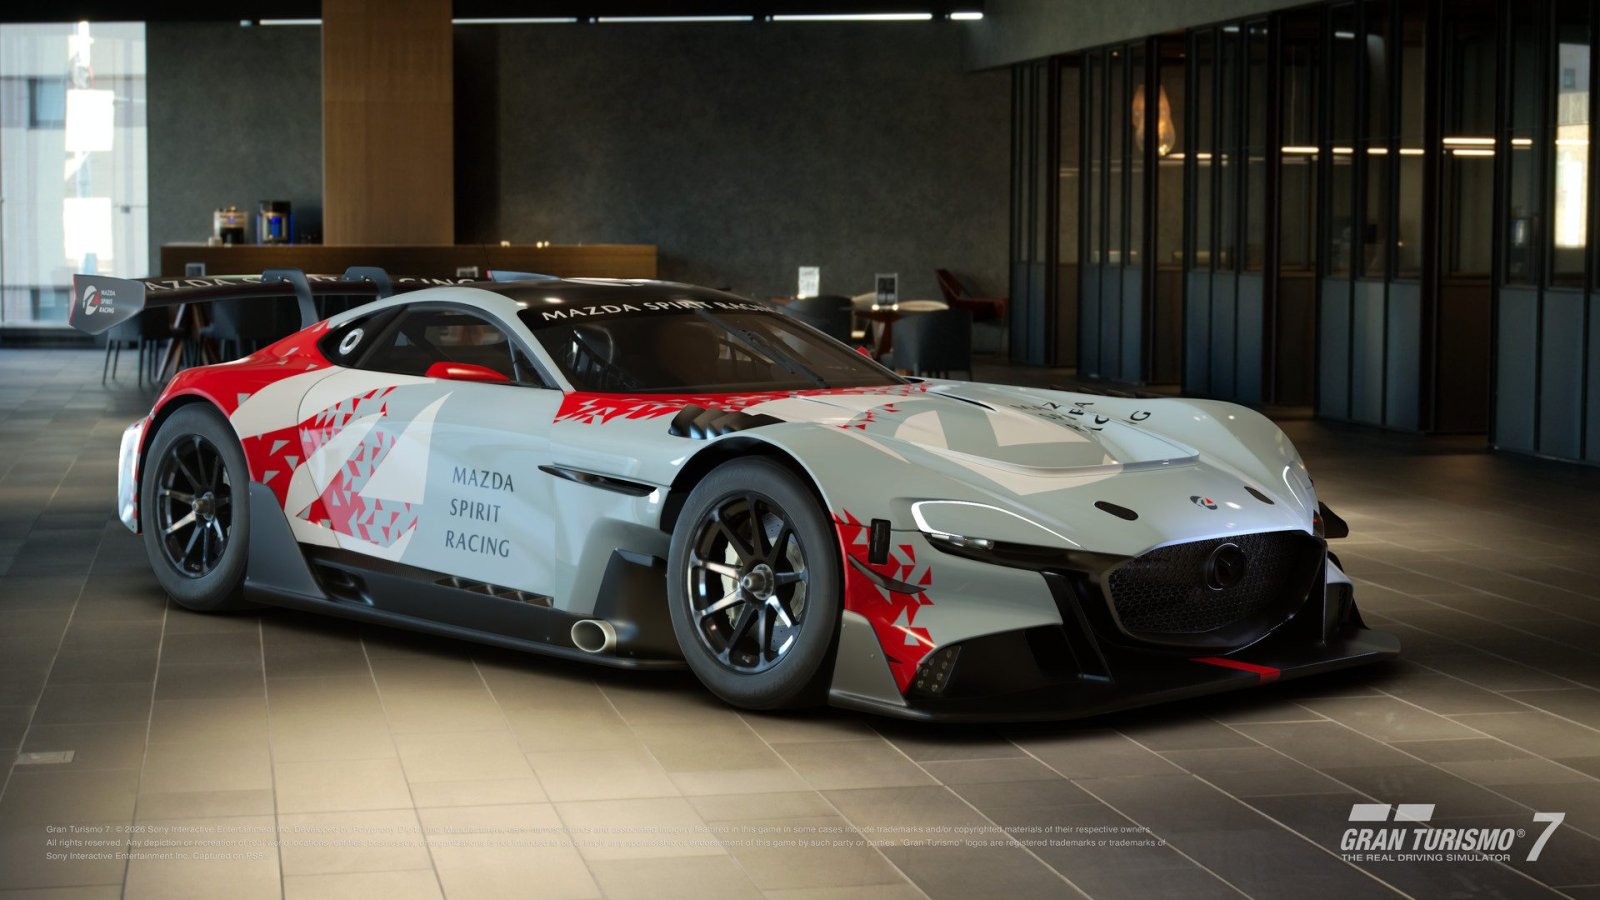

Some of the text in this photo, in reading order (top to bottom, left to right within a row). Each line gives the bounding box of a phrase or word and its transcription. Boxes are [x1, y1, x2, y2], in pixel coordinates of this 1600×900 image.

[144, 278, 236, 291] AZDA
[542, 302, 641, 320] MAZDA
[643, 300, 713, 310] SPIRIT
[452, 466, 514, 493] MAZDA
[449, 498, 501, 523] SPIRIT
[445, 530, 510, 558] RACING
